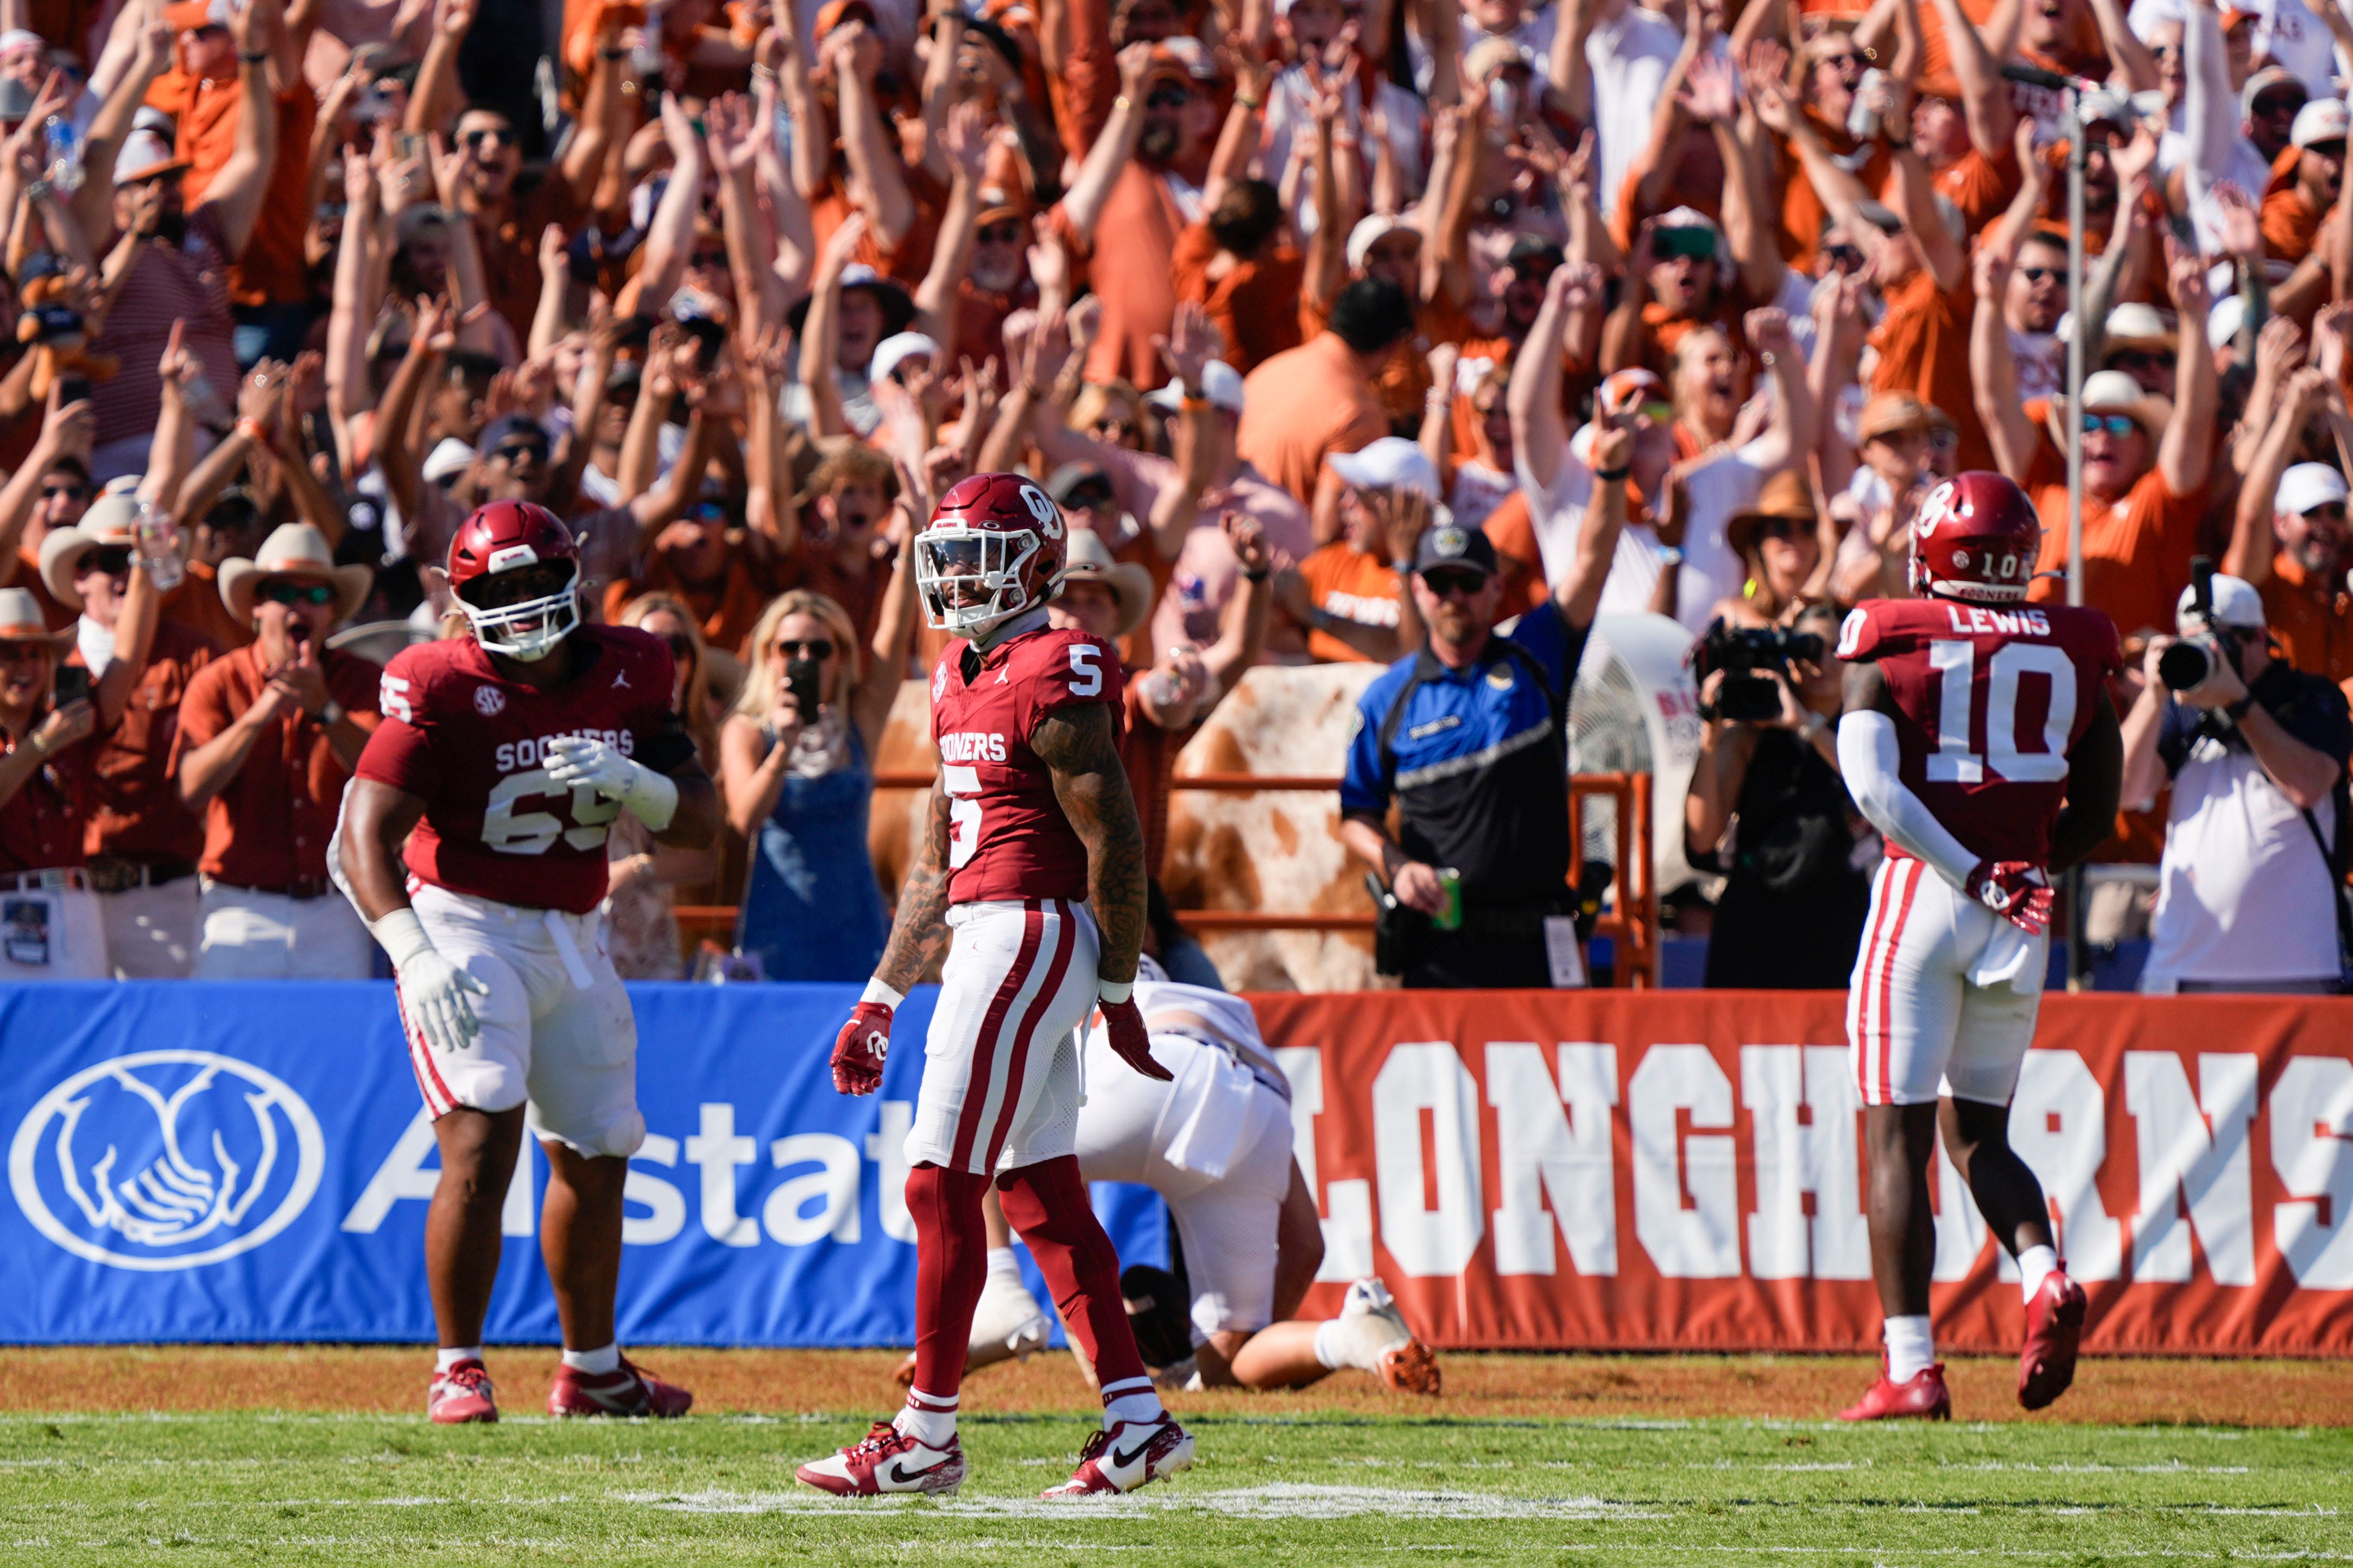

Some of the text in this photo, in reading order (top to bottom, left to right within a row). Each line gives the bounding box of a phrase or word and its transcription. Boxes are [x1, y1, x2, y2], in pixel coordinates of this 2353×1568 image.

[1982, 553, 2017, 579] 10
[1947, 605, 2051, 636] LEWIS
[1069, 644, 1102, 696] 5
[379, 671, 412, 723] 5
[1926, 639, 2077, 783] 10
[496, 728, 634, 772] SOOERS
[480, 768, 623, 854] 65
[942, 764, 983, 868] 5
